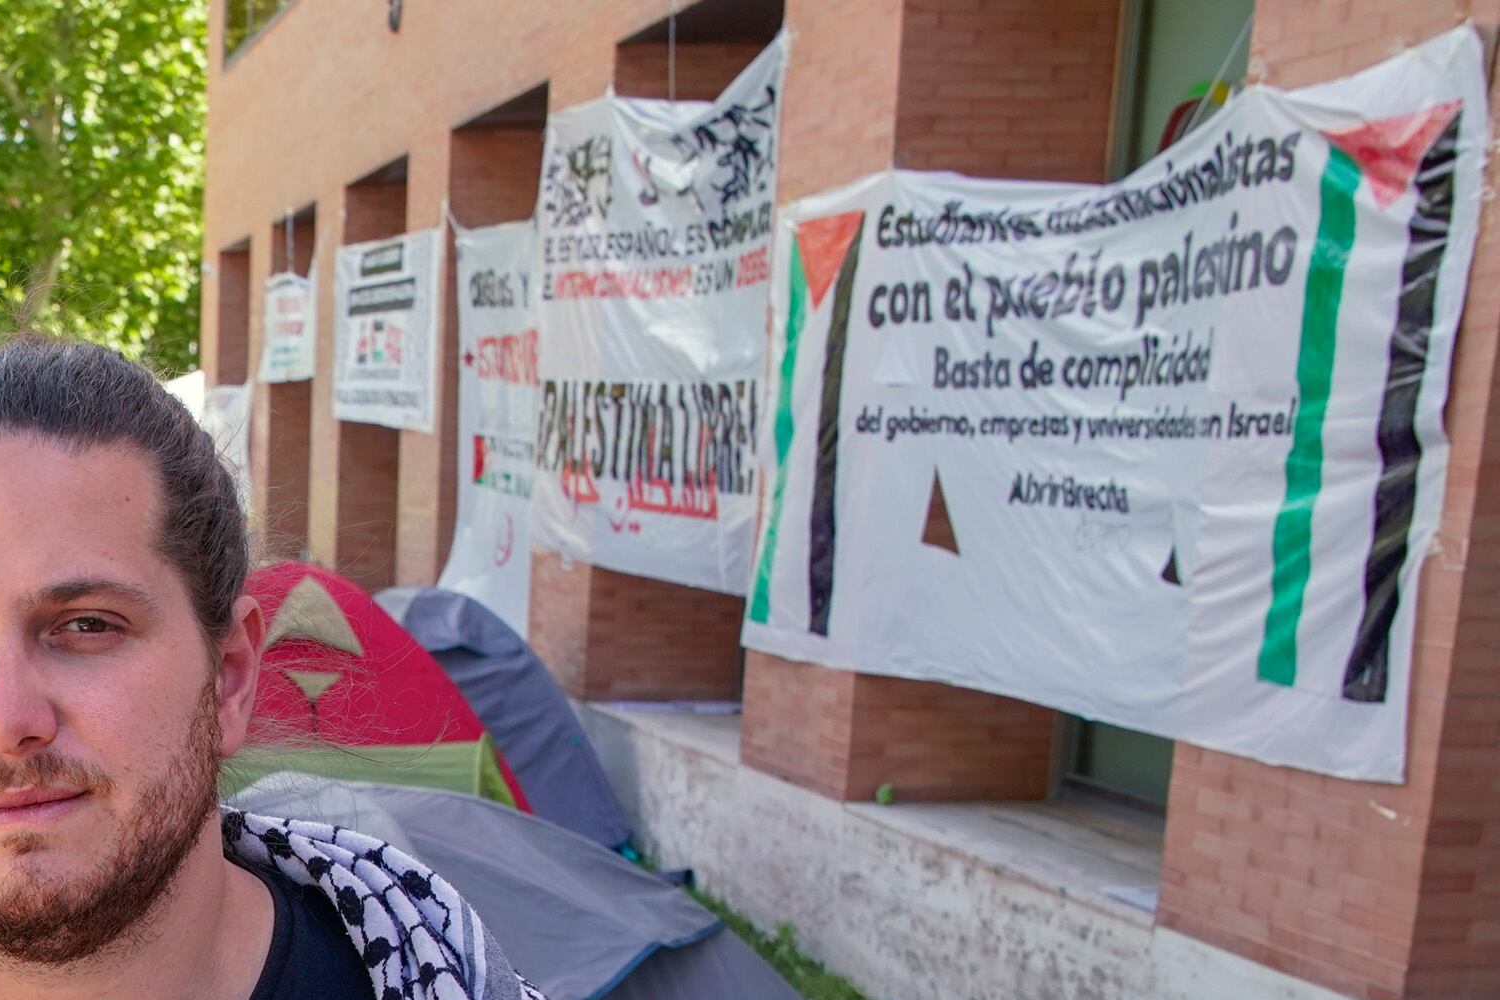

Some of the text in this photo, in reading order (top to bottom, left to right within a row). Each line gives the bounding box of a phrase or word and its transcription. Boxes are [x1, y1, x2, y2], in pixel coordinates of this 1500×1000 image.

[868, 280, 932, 328] con
[944, 262, 976, 321] el
[1134, 211, 1298, 329] palestino
[933, 327, 1214, 401] Basta de complicidad
[856, 406, 884, 434] del
[980, 415, 1069, 442] empresas
[1072, 416, 1084, 444] y
[1227, 397, 1297, 439] Israel
